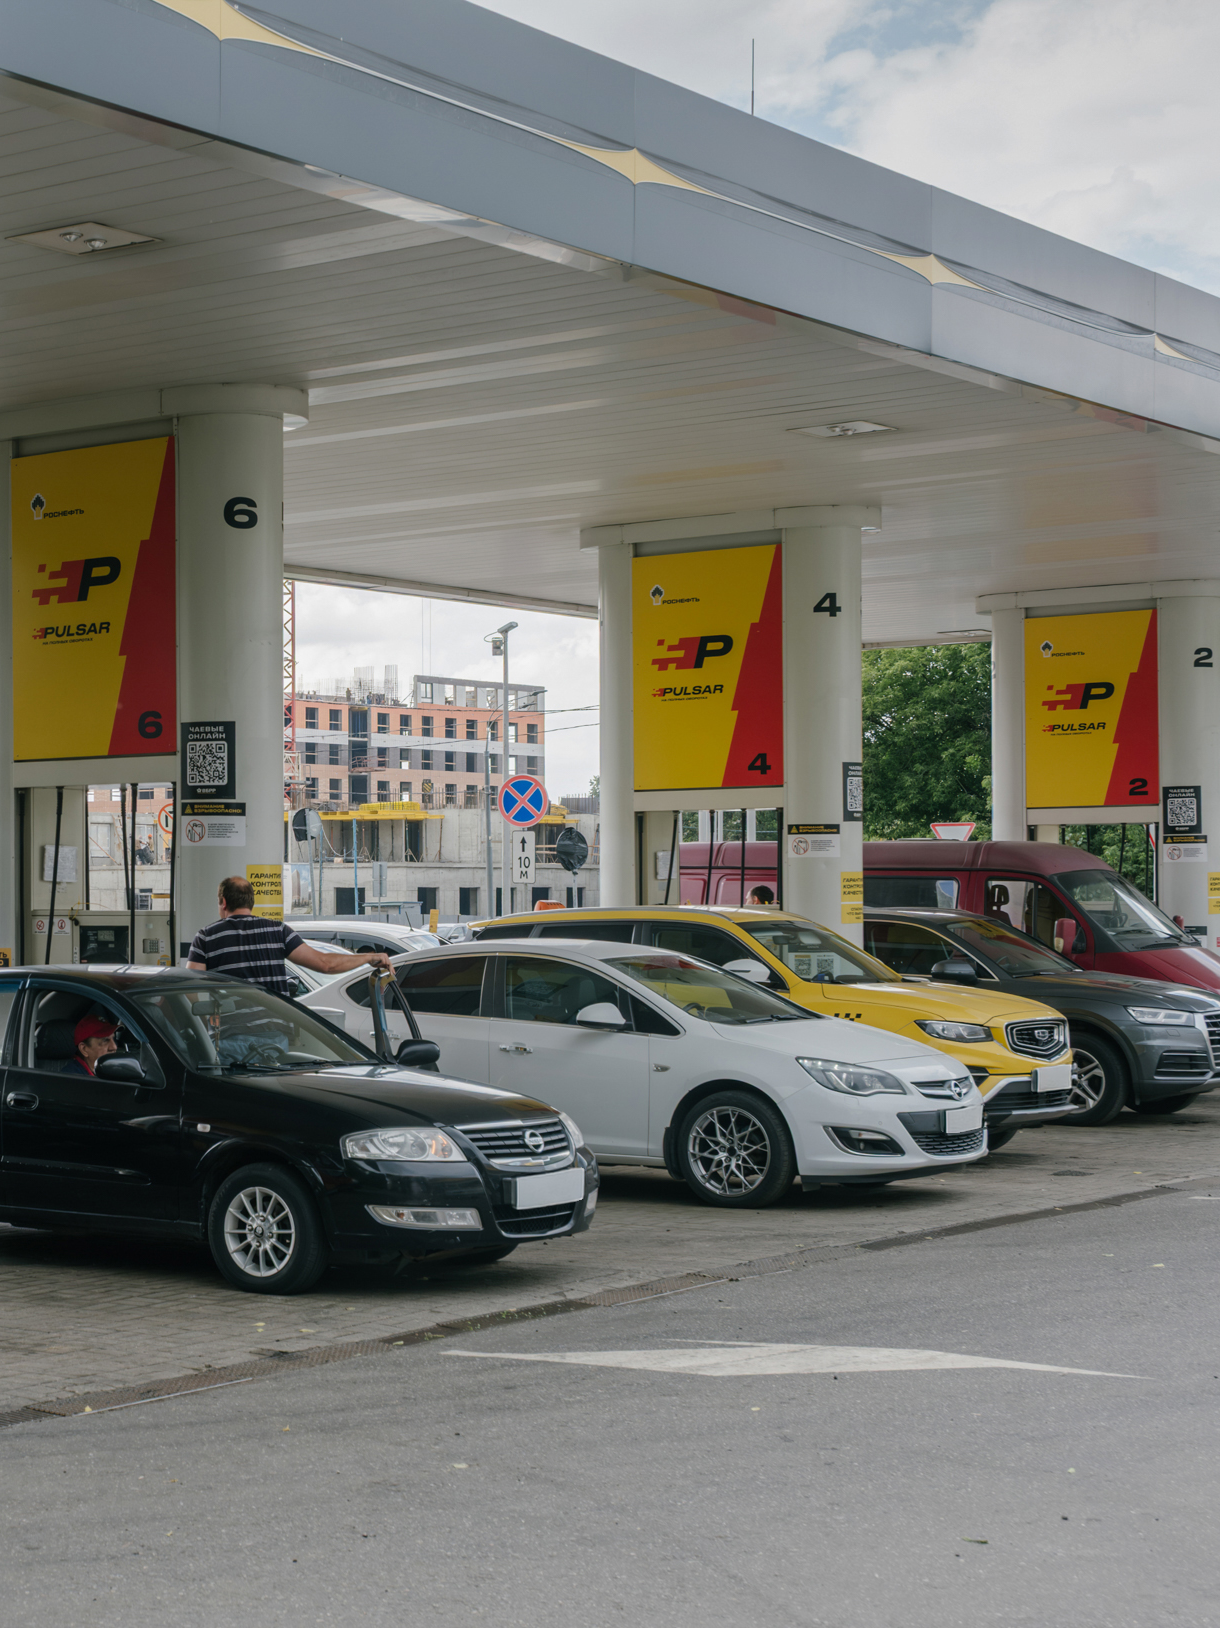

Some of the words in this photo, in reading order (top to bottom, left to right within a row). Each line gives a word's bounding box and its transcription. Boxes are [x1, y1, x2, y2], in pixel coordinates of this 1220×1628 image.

[44, 509, 84, 518] РОСНЕФТЬ
[224, 496, 258, 530] 6
[813, 593, 841, 617] 4
[44, 622, 110, 639] PULSAR
[1194, 648, 1213, 667] 2
[663, 684, 724, 696] PULSAR
[138, 710, 163, 739] 6
[1052, 722, 1106, 732] PULSAR
[748, 753, 771, 775] 4
[1129, 778, 1148, 796] 2
[518, 856, 530, 868] 10
[520, 870, 528, 879] М
